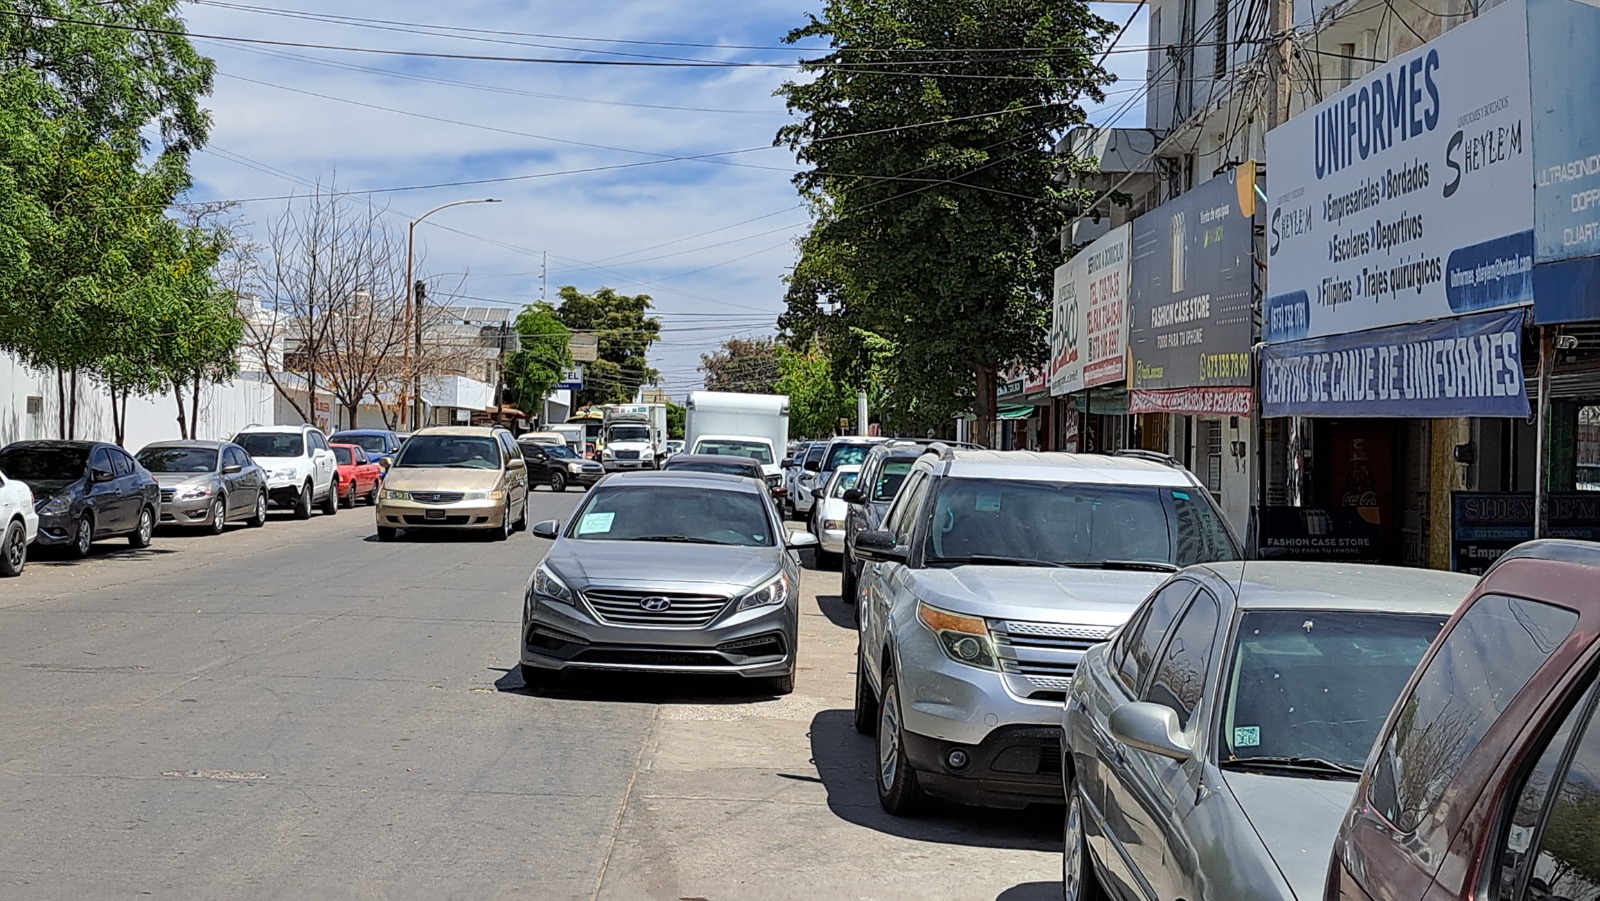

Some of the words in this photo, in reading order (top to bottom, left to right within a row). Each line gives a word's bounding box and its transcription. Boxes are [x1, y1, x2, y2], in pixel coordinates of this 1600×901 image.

[1313, 48, 1440, 180] UNIFORMES
[1327, 177, 1380, 226] Empresariales
[1387, 157, 1429, 200] Bordados
[1571, 189, 1600, 213] DOPP
[1333, 228, 1370, 263] Escolares
[1376, 210, 1423, 256] Deportivos
[1563, 221, 1600, 246] CUART
[1322, 274, 1352, 311] Filipinas
[1362, 264, 1388, 304] Trajes
[1390, 252, 1442, 300] quirúrgicos
[1151, 302, 1174, 328] FASHION
[1174, 299, 1190, 324] CASE
[1190, 294, 1210, 321] STORE
[1239, 353, 1249, 377] 99
[1265, 356, 1308, 403] CENTRO
[1311, 353, 1330, 402] DE
[1330, 347, 1375, 401] CANJE
[1378, 345, 1400, 400] DE
[1402, 332, 1521, 400] UNIFORMES
[1465, 498, 1600, 520] SHEYE'M
[1267, 538, 1309, 546] FASHION
[1311, 538, 1337, 546] CASE
[1338, 538, 1370, 546] STORE
